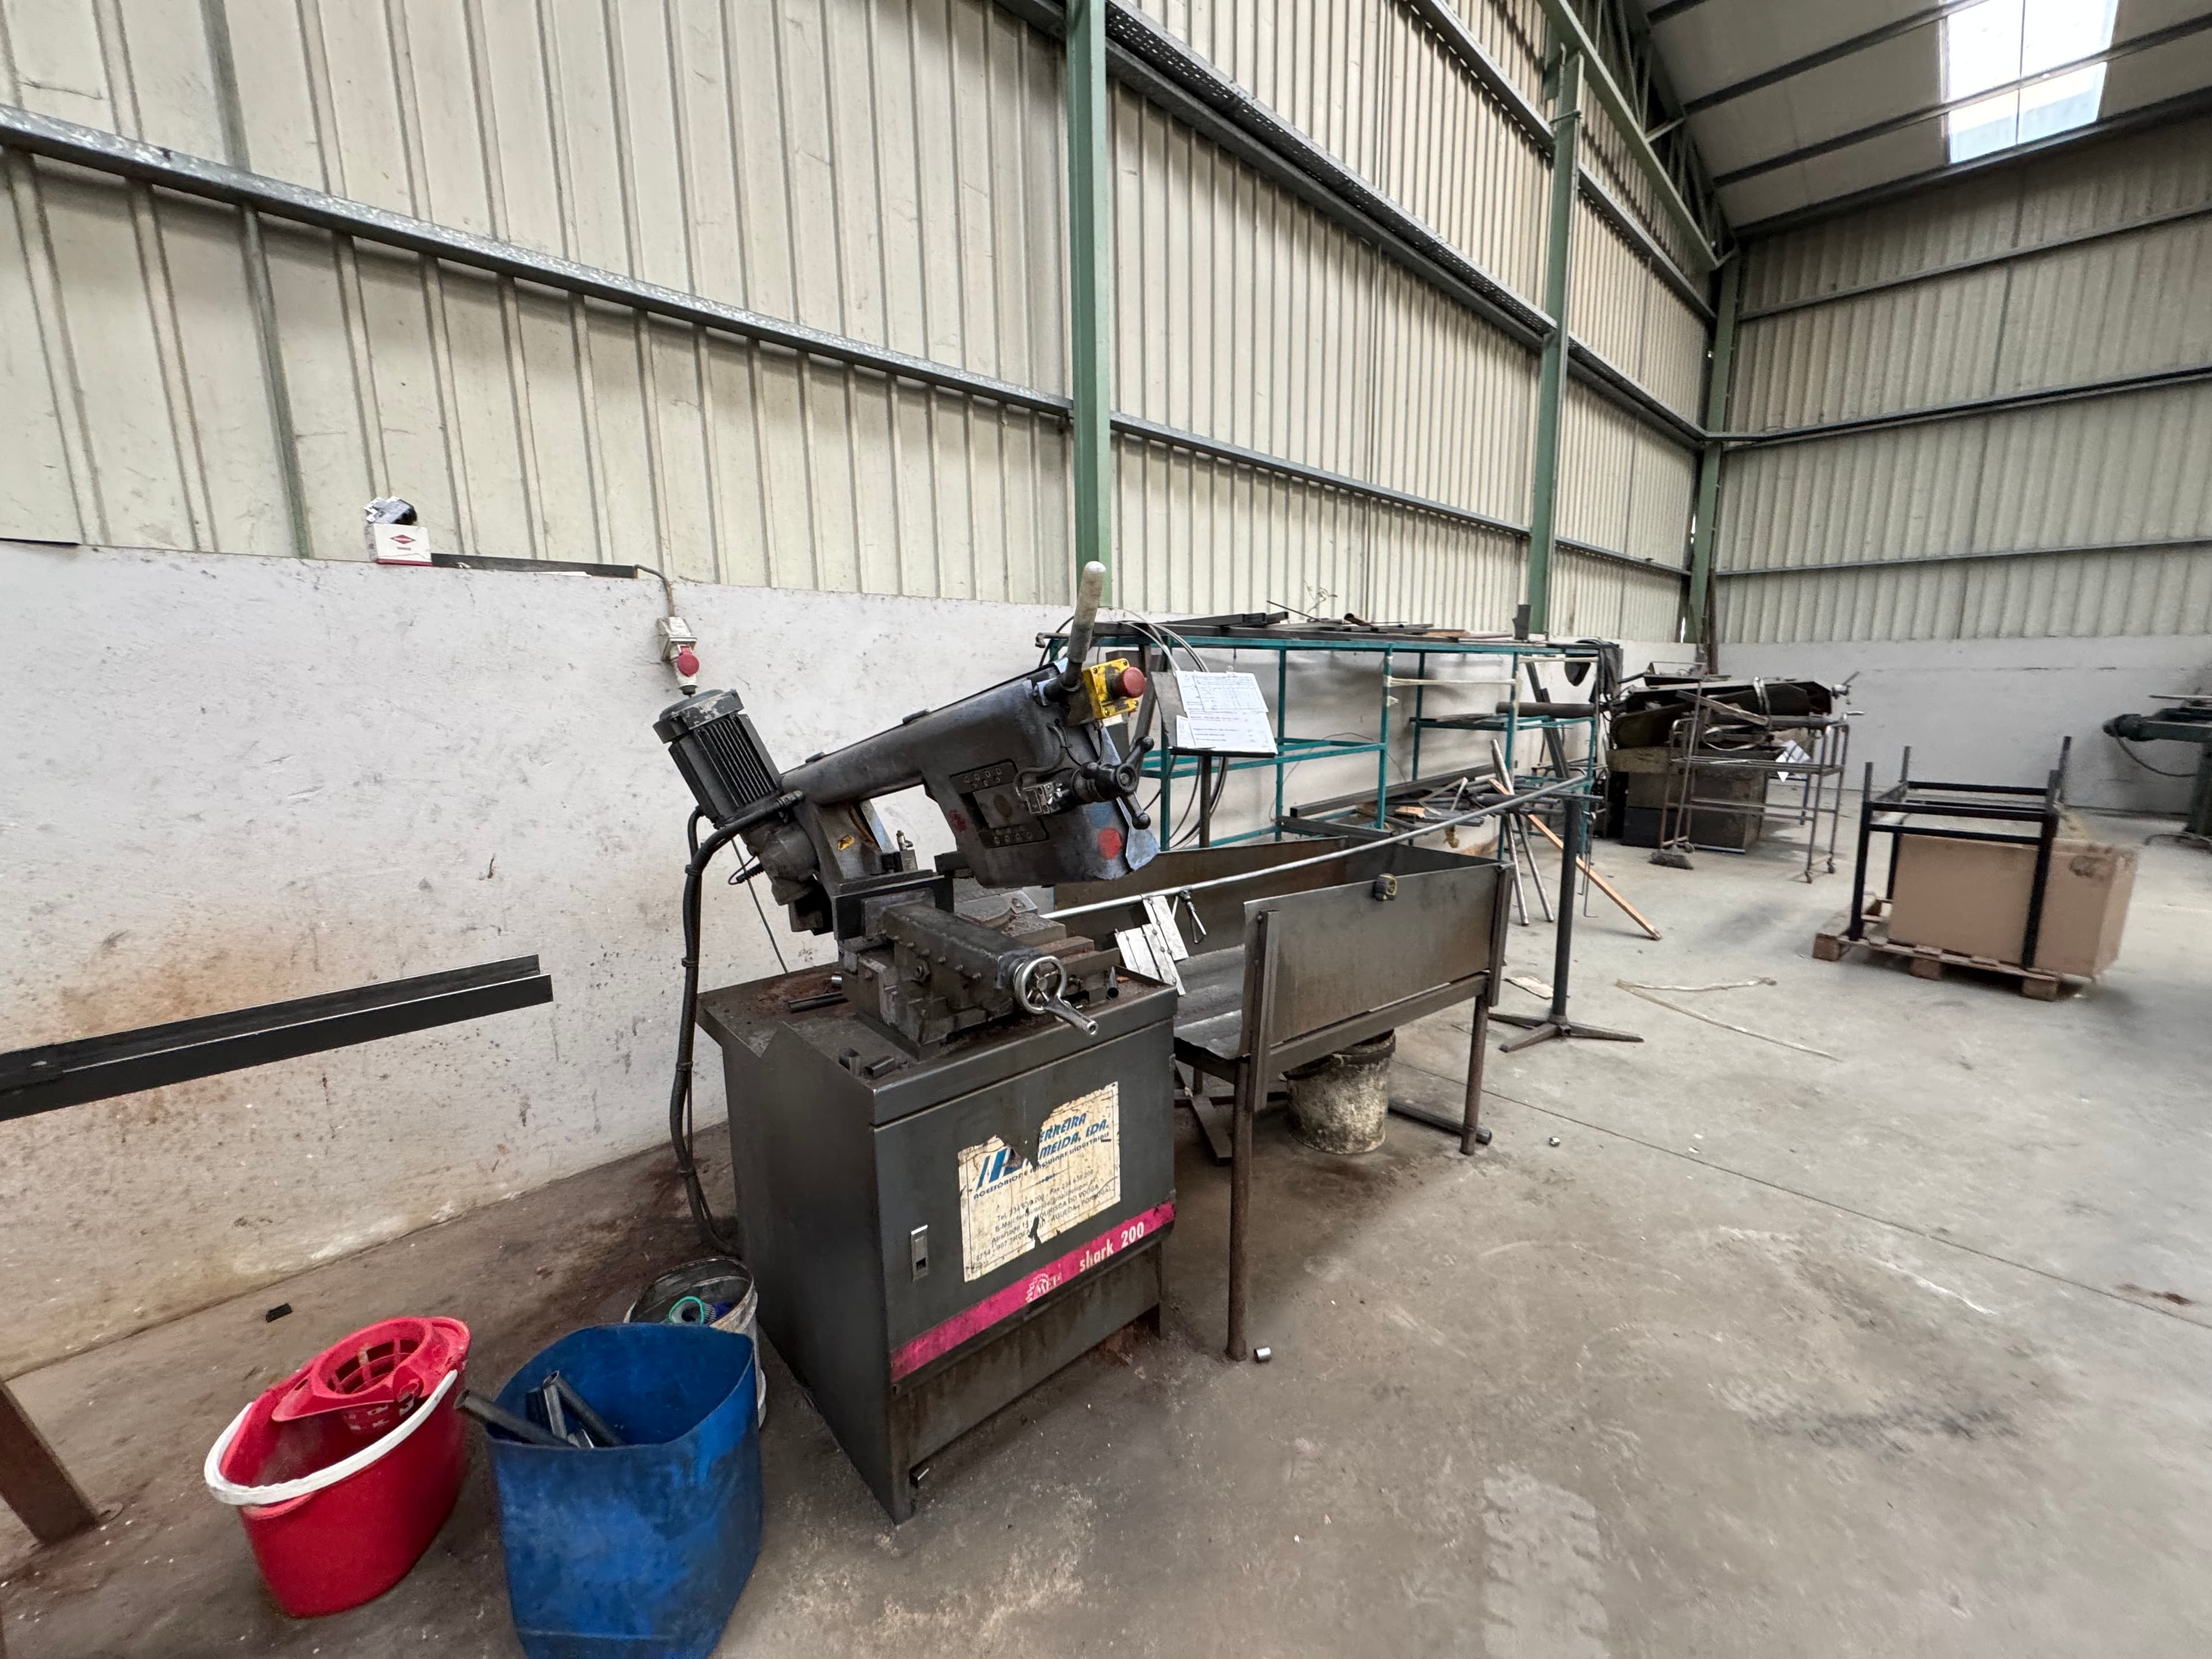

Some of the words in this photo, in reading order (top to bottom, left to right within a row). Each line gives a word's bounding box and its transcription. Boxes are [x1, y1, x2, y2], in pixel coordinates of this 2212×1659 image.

[1039, 1112, 1086, 1143] ERREIRA
[1080, 1238, 1114, 1272] shark
[1121, 1222, 1144, 1249] 200
